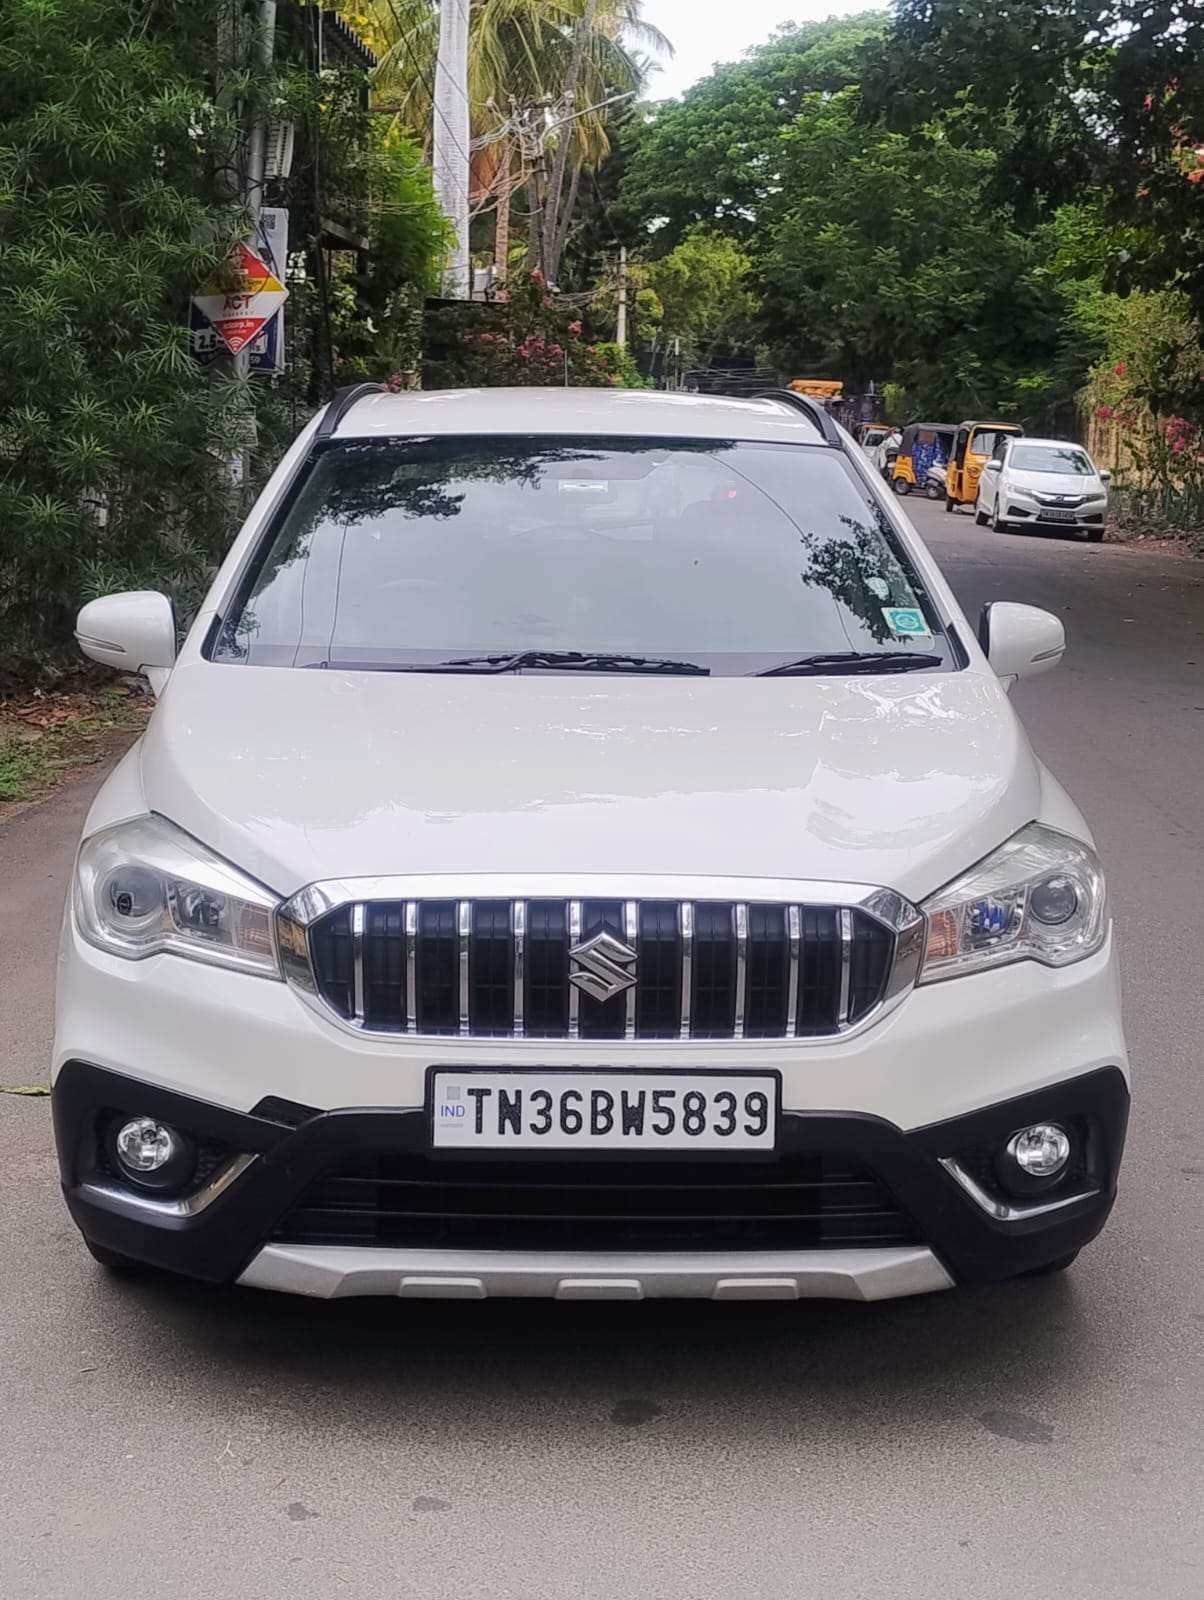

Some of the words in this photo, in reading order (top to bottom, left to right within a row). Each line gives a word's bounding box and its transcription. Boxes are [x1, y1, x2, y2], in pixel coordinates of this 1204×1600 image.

[223, 294, 253, 310] ACT
[440, 1104, 466, 1118] IND
[467, 1088, 769, 1137] TN36BW5839
